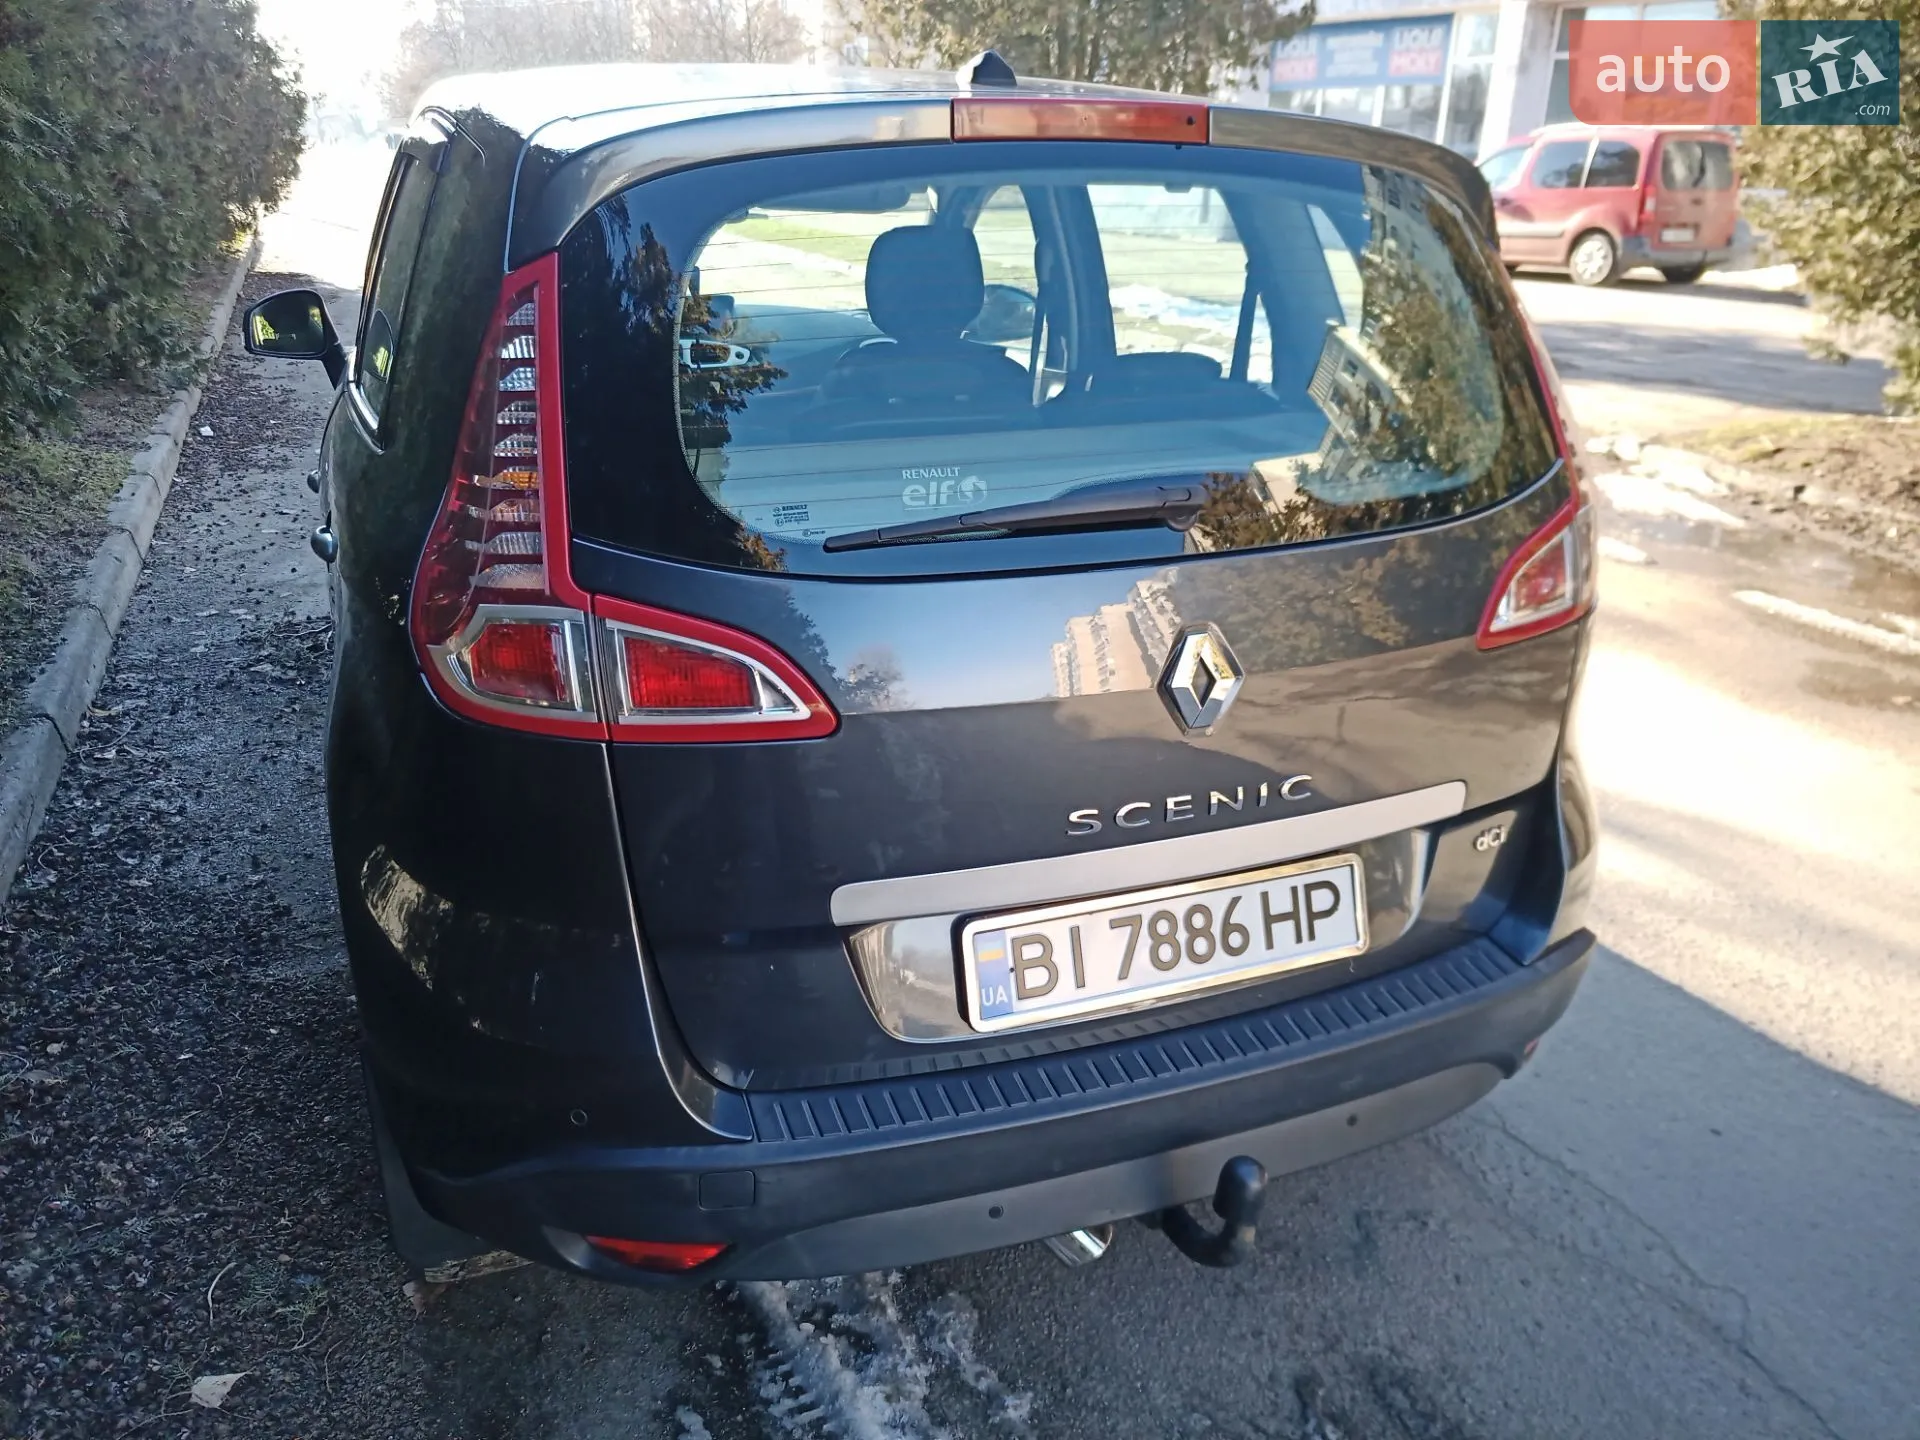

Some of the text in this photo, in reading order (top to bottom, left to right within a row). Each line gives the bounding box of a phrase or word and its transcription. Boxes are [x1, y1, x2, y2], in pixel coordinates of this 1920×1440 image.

[902, 467, 960, 480] RENAULT
[902, 480, 955, 506] elf
[1064, 775, 1313, 835] SCENIC
[1475, 825, 1506, 852] dCi
[1012, 879, 1341, 1000] BI 7886 HP
[981, 985, 1009, 1006] UA
